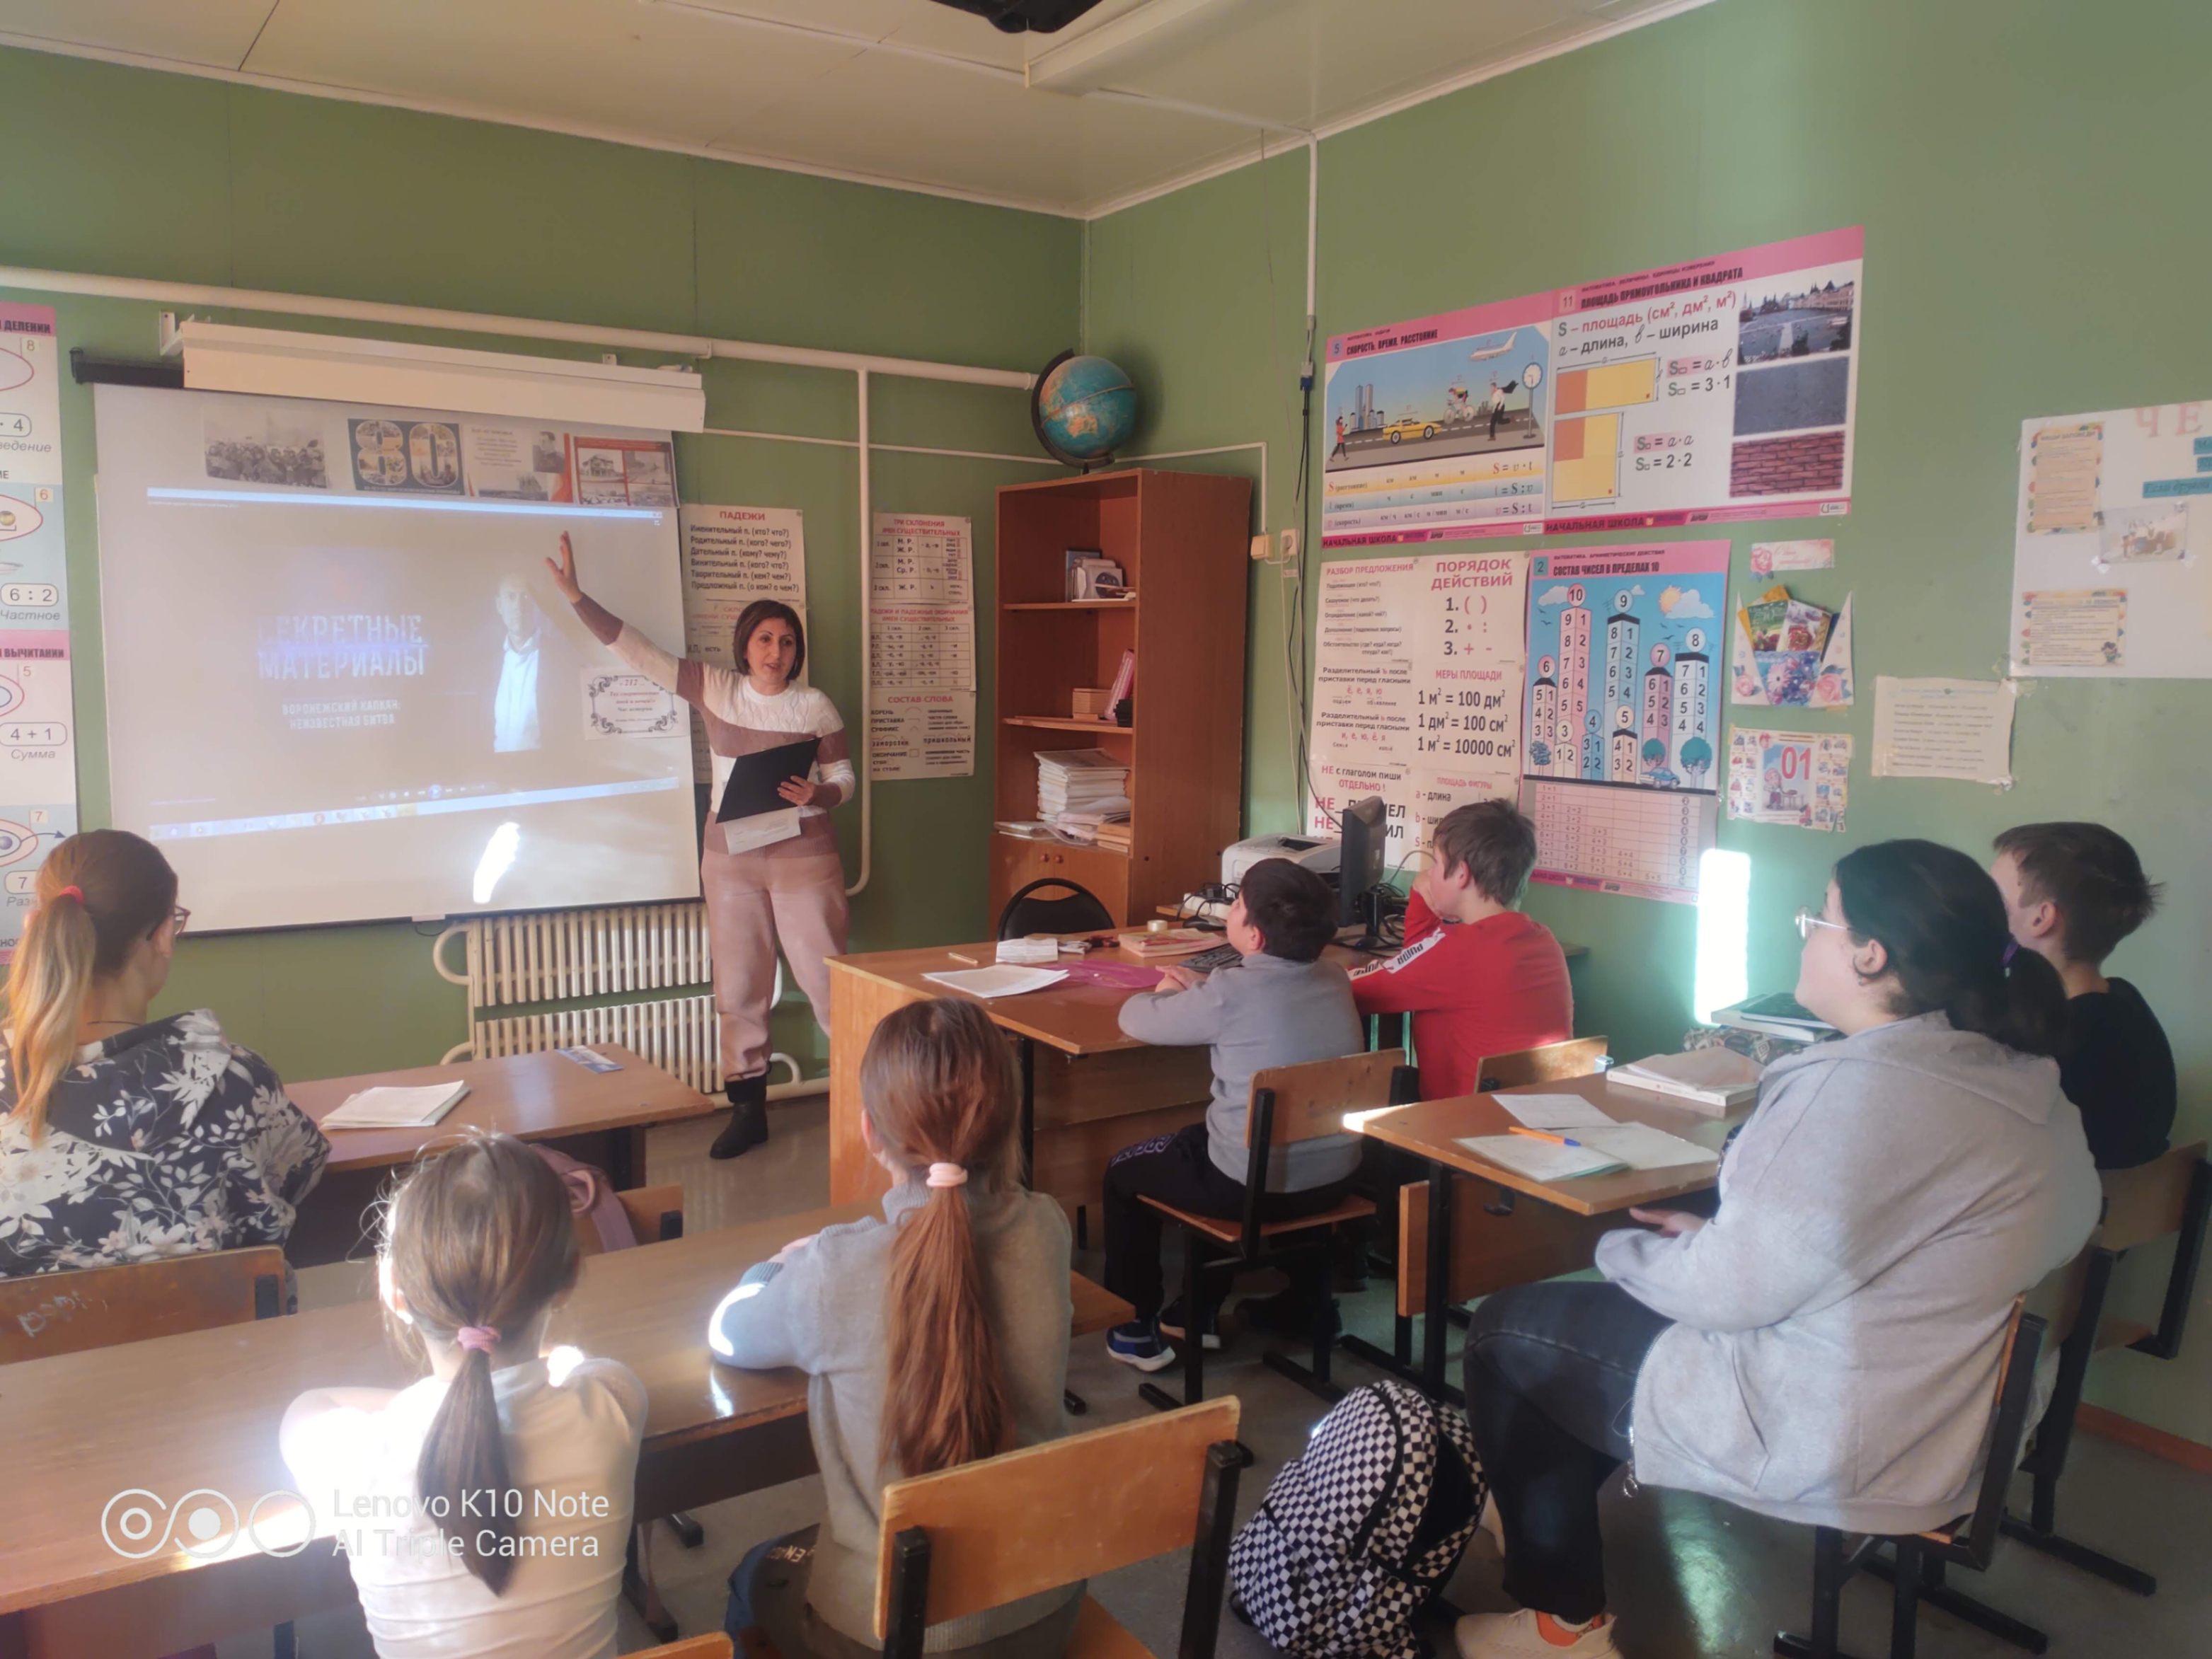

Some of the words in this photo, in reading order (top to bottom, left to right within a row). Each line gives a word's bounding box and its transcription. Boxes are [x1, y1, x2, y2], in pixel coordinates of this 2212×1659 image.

[1581, 293, 1618, 308] ПЛОЩАДЬ
[1693, 277, 1698, 287] И
[1700, 267, 1743, 285] КВАДРАТА
[1562, 296, 1574, 308] 11
[4, 320, 50, 334] ДЕЛЕНИИ
[1558, 322, 1567, 336] S
[1582, 313, 1643, 333] площадь
[1659, 318, 1718, 339] ширина
[1401, 329, 1438, 345] РАССТОЯНИЕ
[26, 340, 35, 351] 8
[1334, 343, 1340, 354] 5
[13, 419, 23, 432] 4
[355, 420, 461, 487] 80
[40, 489, 49, 499] 6
[719, 511, 766, 521] ПАДЕЖИ
[1545, 519, 1605, 533] НАЧАЛЬНАЯ
[1607, 516, 1644, 529] ШКОЛА
[1323, 536, 1367, 548] НАЧАЛЬНАЯ
[1369, 534, 1397, 545] ШКОЛА
[1326, 567, 1353, 576] РАЗБОР
[1355, 563, 1414, 574] ПРЕДЛОЖЕНИЯ
[1436, 559, 1511, 573] ПОРЯДОК
[1537, 561, 1544, 573] 2
[1553, 565, 1581, 577] СОСТАВ
[1581, 565, 1605, 574] ЧИСЕЛ
[1606, 565, 1612, 573] В
[1612, 562, 1650, 574] ПРЕДЕЛАХ
[1652, 562, 1660, 572] 10
[1431, 572, 1513, 591] ДЕЙСТВИЙ
[10, 589, 20, 601] 6
[42, 589, 52, 601] 2
[1569, 589, 1583, 601] 10
[1620, 595, 1628, 608] 9
[1446, 597, 1459, 611] 1.
[1, 610, 60, 621] Частное
[1565, 614, 1572, 626] 9
[1581, 615, 1586, 625] 1
[1445, 619, 1458, 633] 2.
[1564, 635, 1571, 647] 8
[1579, 635, 1586, 646] 2
[1691, 635, 1700, 647] 8
[4, 648, 64, 659] ВЫЧИТАНИИ
[1444, 641, 1458, 655] 3.
[1657, 649, 1664, 662] 7
[257, 647, 425, 680] МАТЕРИАЛЫ
[1543, 661, 1550, 673] 6
[1563, 657, 1570, 670] 7
[1579, 657, 1585, 669] 3
[23, 666, 32, 677] 5
[1323, 666, 1380, 675] Разделительный
[1436, 670, 1458, 679] МЕРЫ
[1461, 671, 1502, 681] ПЛОЩАДИ
[1682, 665, 1690, 677] 7
[1700, 666, 1705, 677] 1
[1562, 678, 1569, 689] 6
[1577, 678, 1584, 689] 4
[1418, 690, 1425, 705] 1
[1459, 690, 1480, 707] 100
[1561, 699, 1568, 711] 5
[1577, 700, 1584, 712] 5
[1321, 712, 1379, 720] Разделительный
[1418, 713, 1425, 728] 1
[1463, 715, 1486, 732] 100
[1589, 716, 1596, 727] 4
[1622, 711, 1628, 723] 5
[1356, 722, 1376, 730] перед
[1562, 725, 1568, 737] 3
[1678, 719, 1686, 731] 4
[1697, 721, 1704, 733] 4
[11, 729, 21, 740] 4
[45, 729, 52, 740] 1
[1418, 736, 1424, 751] 1
[1455, 739, 1494, 756] 10000
[11, 749, 55, 761] Сумма
[1781, 747, 1811, 781] 01
[1322, 765, 1335, 775] НЕ
[1342, 768, 1377, 778] глаголом
[1378, 772, 1401, 781] пиши
[1339, 779, 1381, 792] ОТДЕЛЬНО
[1437, 777, 1466, 787] ПЛОЩАДЬ
[1468, 780, 1492, 790] ФИГУРЫ
[1428, 791, 1452, 802] длина
[1315, 797, 1335, 811] НЕ
[35, 811, 43, 822] 7
[1315, 816, 1334, 830] НЕ
[18, 877, 28, 889] 7
